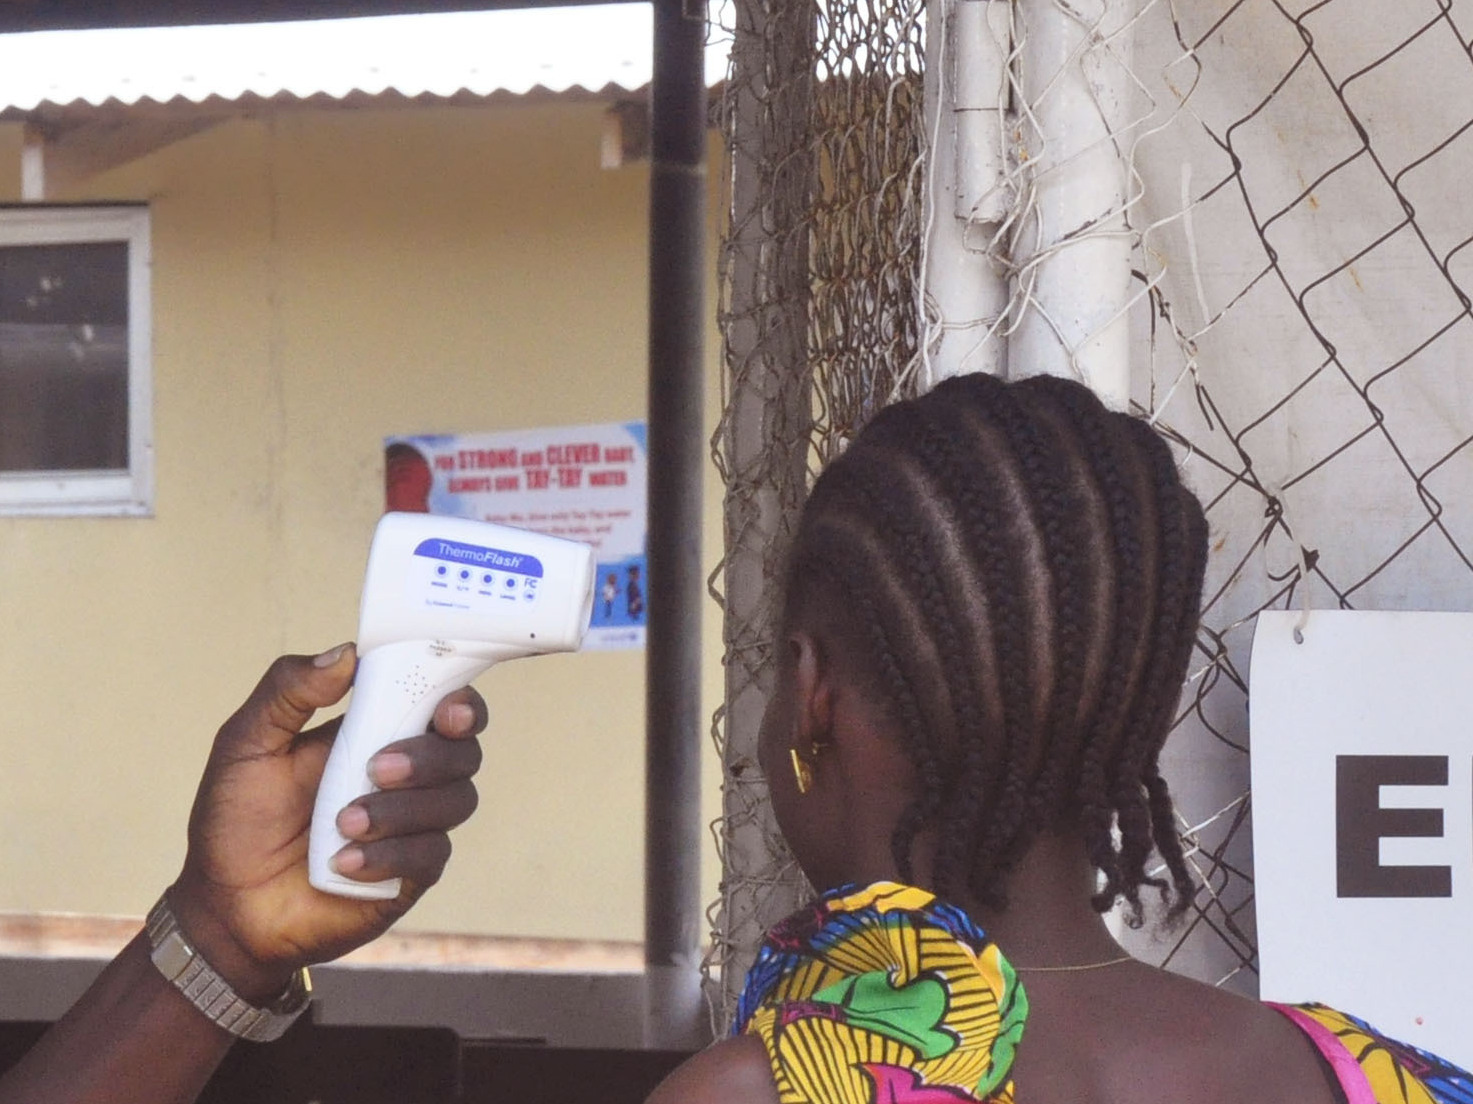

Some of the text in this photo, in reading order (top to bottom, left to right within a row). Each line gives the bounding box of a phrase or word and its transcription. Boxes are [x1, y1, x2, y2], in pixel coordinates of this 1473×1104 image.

[459, 449, 518, 470] STRONG
[546, 443, 600, 465] CLEVER
[439, 542, 520, 569] ThermoFlash
[1335, 755, 1473, 898] E
